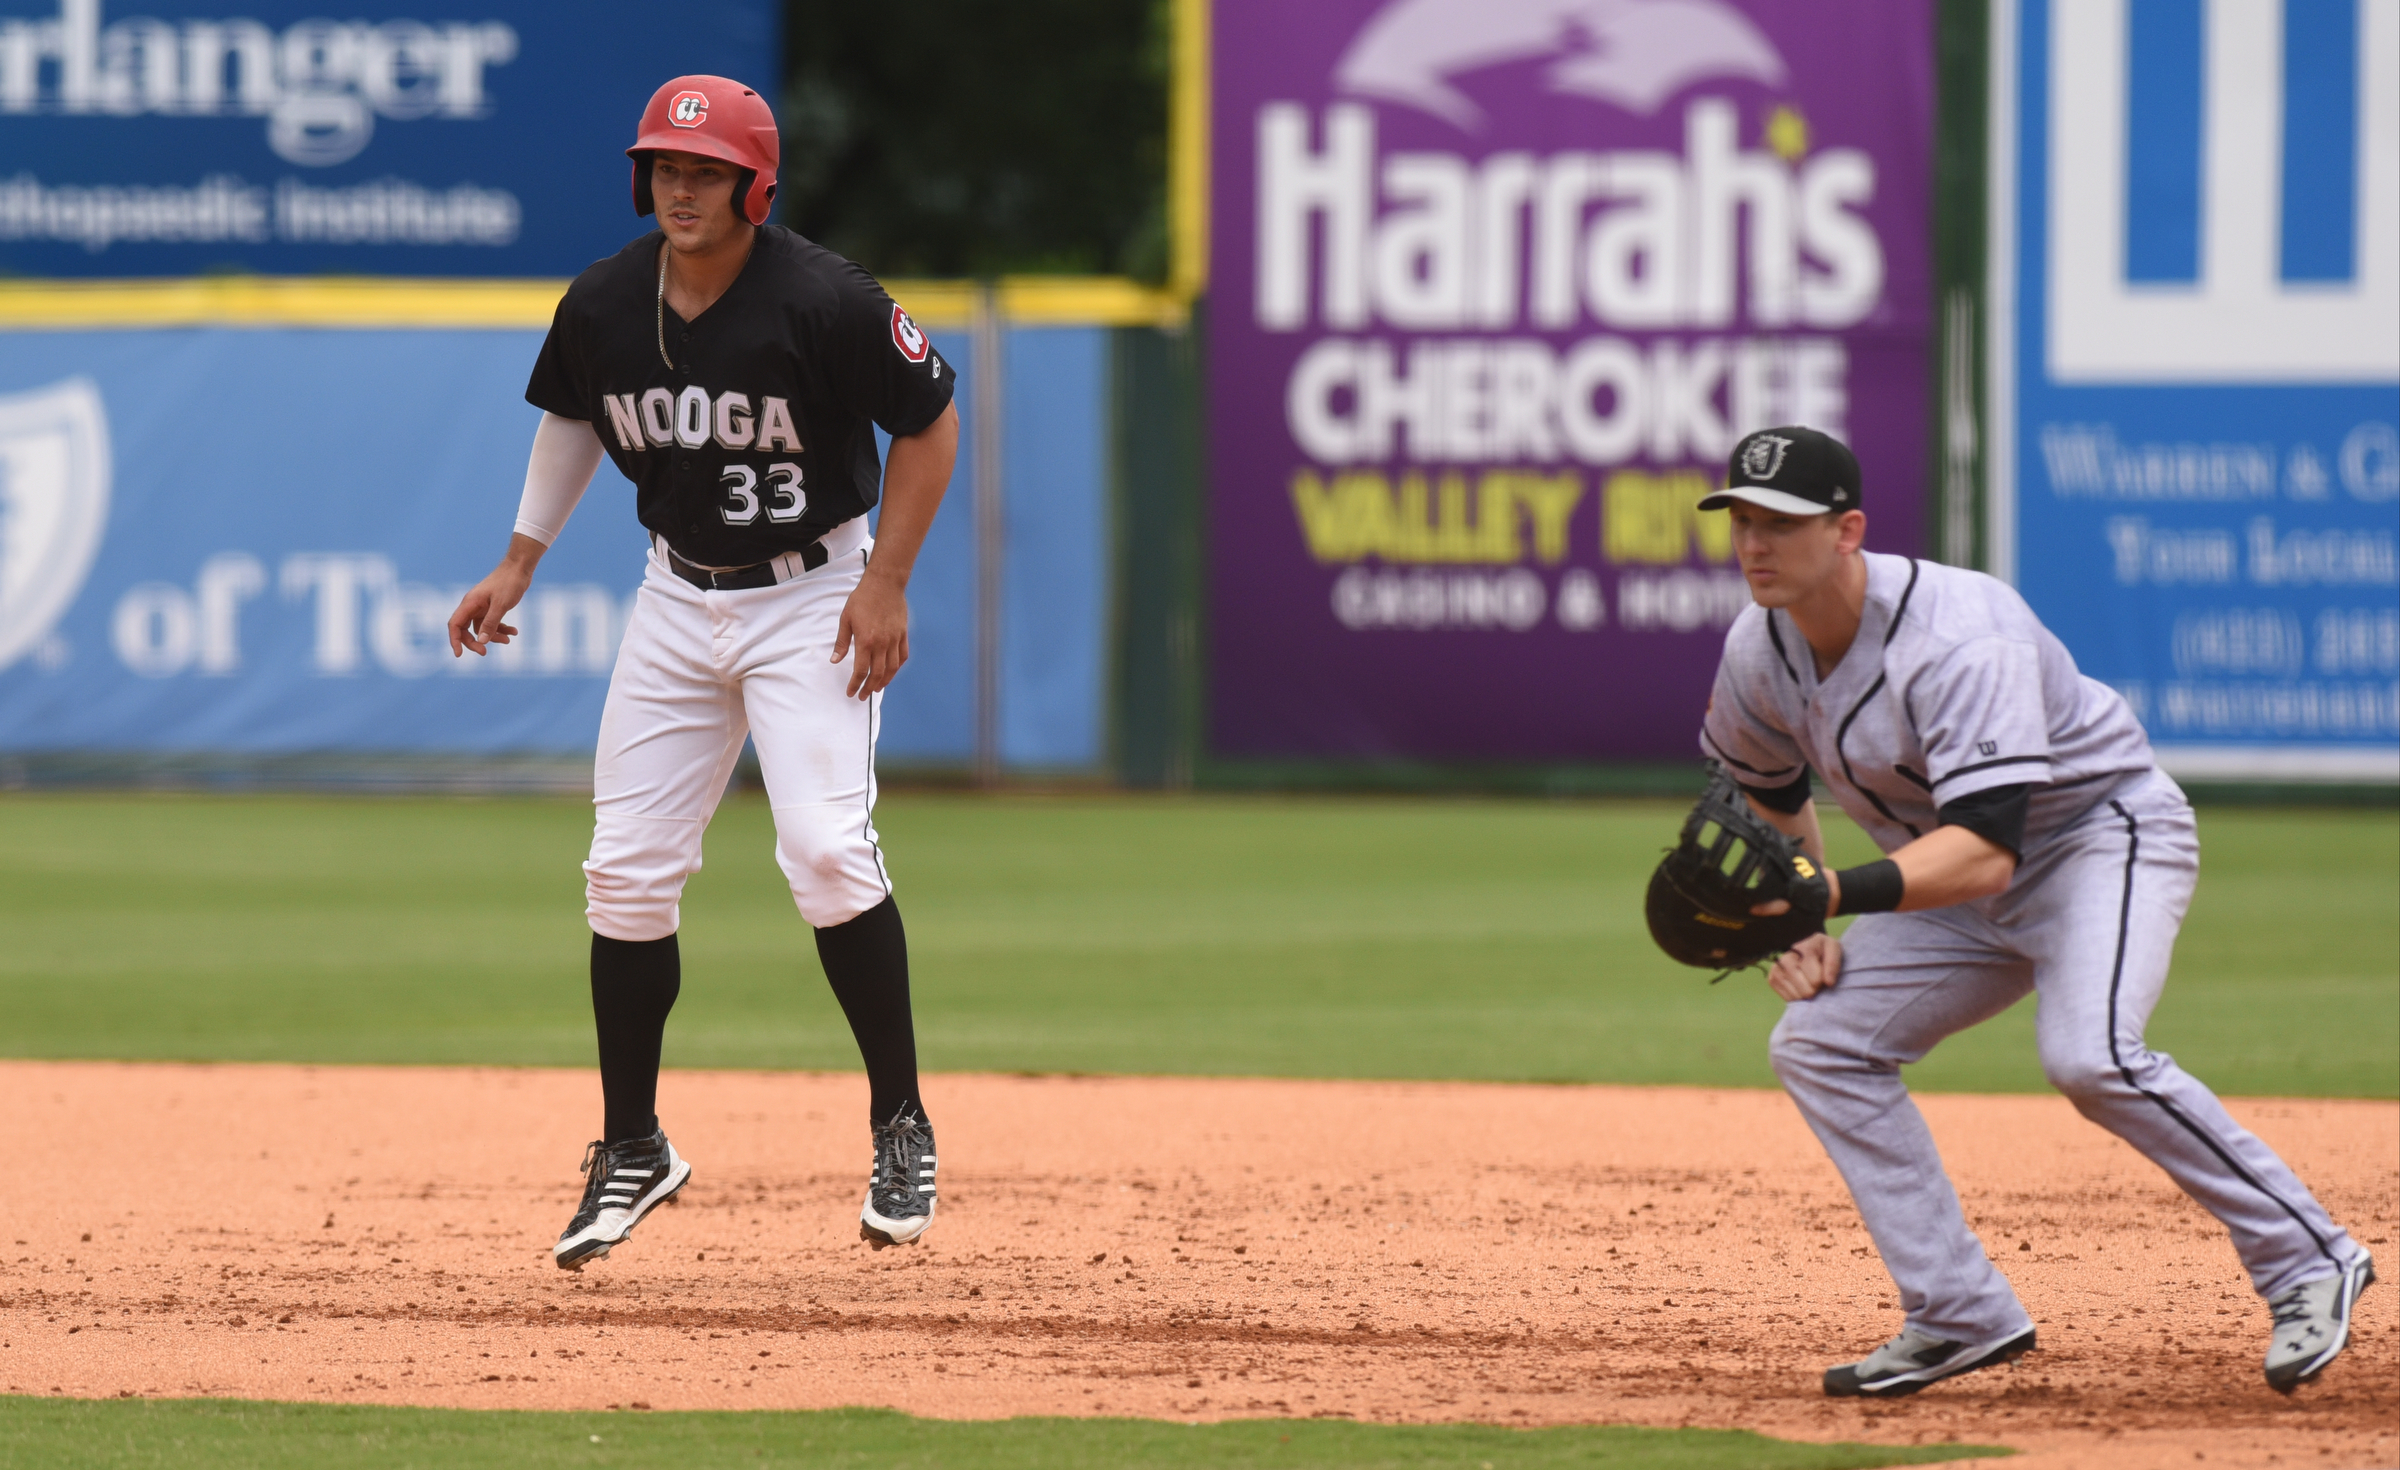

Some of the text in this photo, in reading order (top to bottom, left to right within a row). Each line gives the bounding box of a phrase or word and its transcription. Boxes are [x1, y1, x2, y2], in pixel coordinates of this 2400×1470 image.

[603, 384, 804, 453] NOOGA
[1286, 335, 1850, 468] CHEROKEE
[719, 462, 808, 526] 33
[1292, 468, 1584, 565] VALLEY
[111, 549, 637, 680] of Tenn
